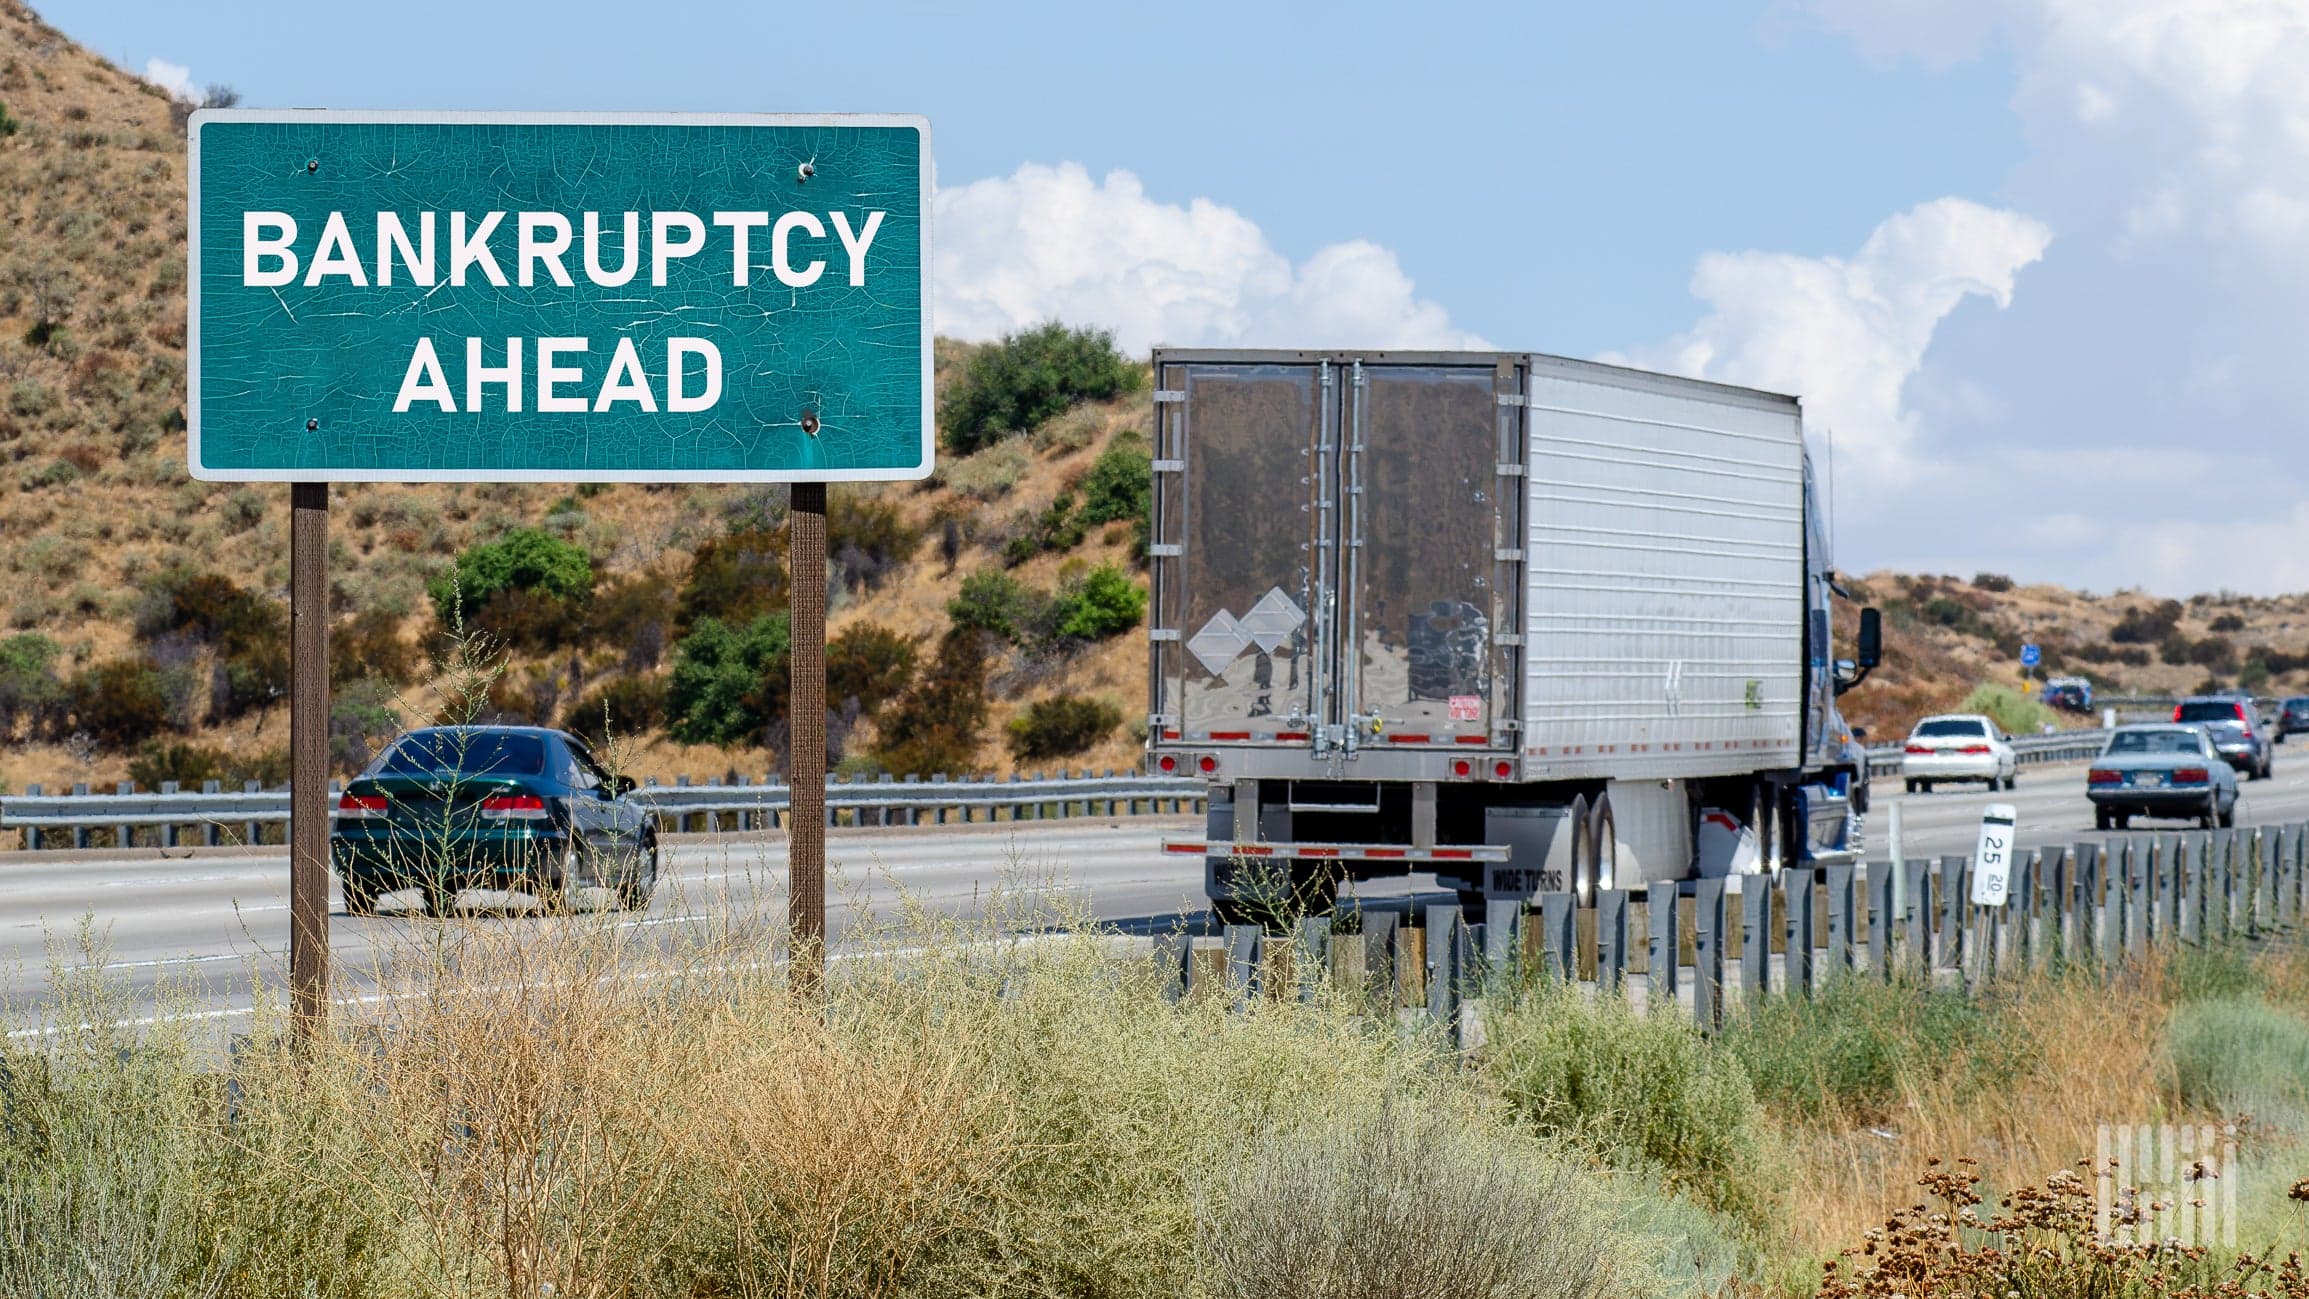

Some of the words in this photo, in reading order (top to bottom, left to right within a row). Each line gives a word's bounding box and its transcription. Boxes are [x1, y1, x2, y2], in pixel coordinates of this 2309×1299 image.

[243, 211, 885, 287] BANKRUPTCY
[392, 337, 722, 412] AHEAD
[1984, 837, 2004, 864] 25
[1493, 869, 1522, 892] WIDE
[1525, 869, 1562, 892] TURNS
[1990, 874, 2004, 892] 20
